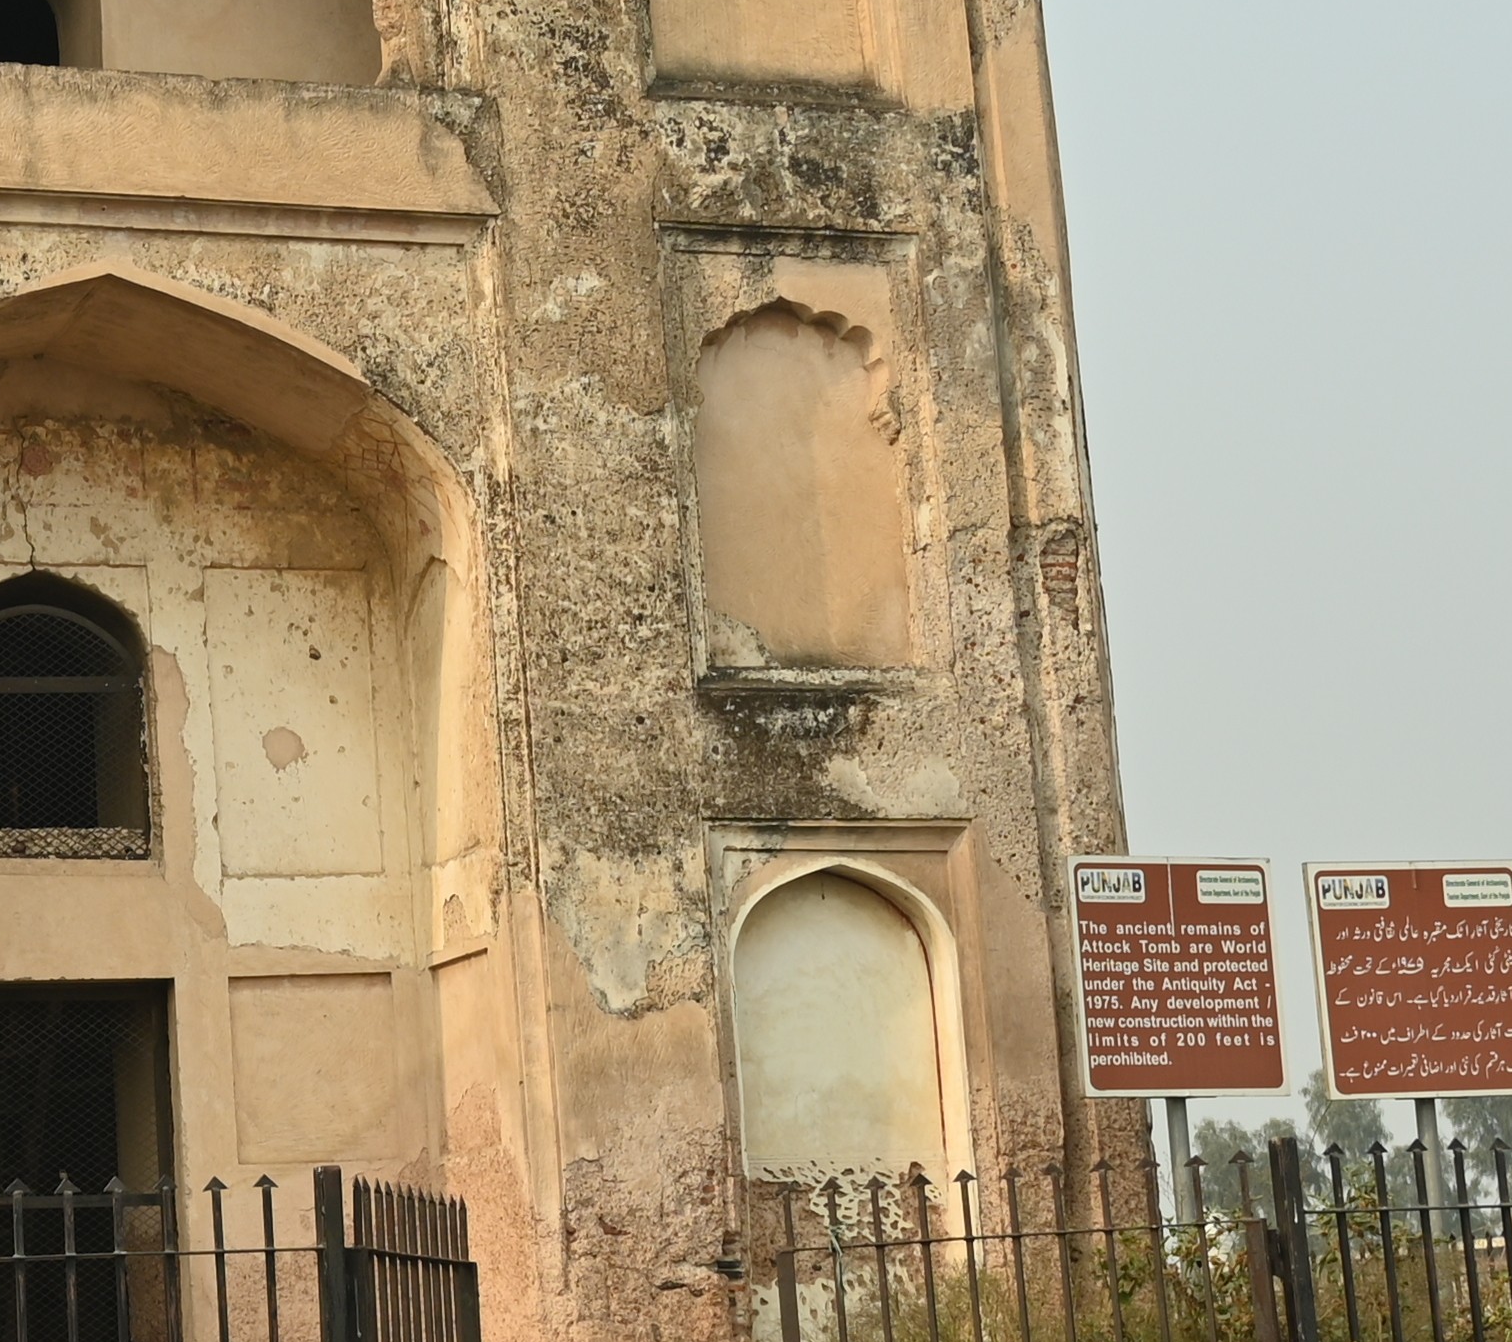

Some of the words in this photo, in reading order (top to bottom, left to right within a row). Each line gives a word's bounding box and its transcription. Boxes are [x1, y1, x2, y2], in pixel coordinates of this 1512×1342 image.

[1080, 871, 1142, 894] PUNJAB
[1321, 878, 1386, 900] PUNJAB
[1080, 921, 1107, 934] The
[1117, 922, 1172, 934] ancient
[1181, 922, 1240, 935] remains
[1251, 922, 1264, 935] of
[1336, 928, 1349, 940] اور
[1082, 940, 1130, 953] Attock
[1139, 940, 1180, 953] Tomb
[1190, 943, 1212, 953] are
[1222, 940, 1266, 953] World
[1083, 958, 1139, 975] Heritage
[1144, 959, 1169, 972] Site
[1174, 959, 1198, 972] and
[1204, 959, 1268, 975] protected
[1085, 977, 1124, 990] under
[1133, 977, 1154, 990] the
[1162, 977, 1225, 993] Antiquity
[1234, 977, 1257, 990] Act
[1087, 996, 1122, 1009] 1975.
[1131, 996, 1158, 1012] Any
[1167, 996, 1259, 1012] development
[1088, 1018, 1115, 1027] new
[1119, 1015, 1204, 1028] construction
[1207, 1014, 1248, 1027] within
[1252, 1014, 1273, 1027] the
[1089, 1033, 1139, 1046] limits
[1150, 1033, 1166, 1046] of
[1177, 1033, 1205, 1046] 200
[1216, 1033, 1249, 1046] feet
[1261, 1033, 1274, 1045] is
[1091, 1052, 1172, 1068] perohibited.
